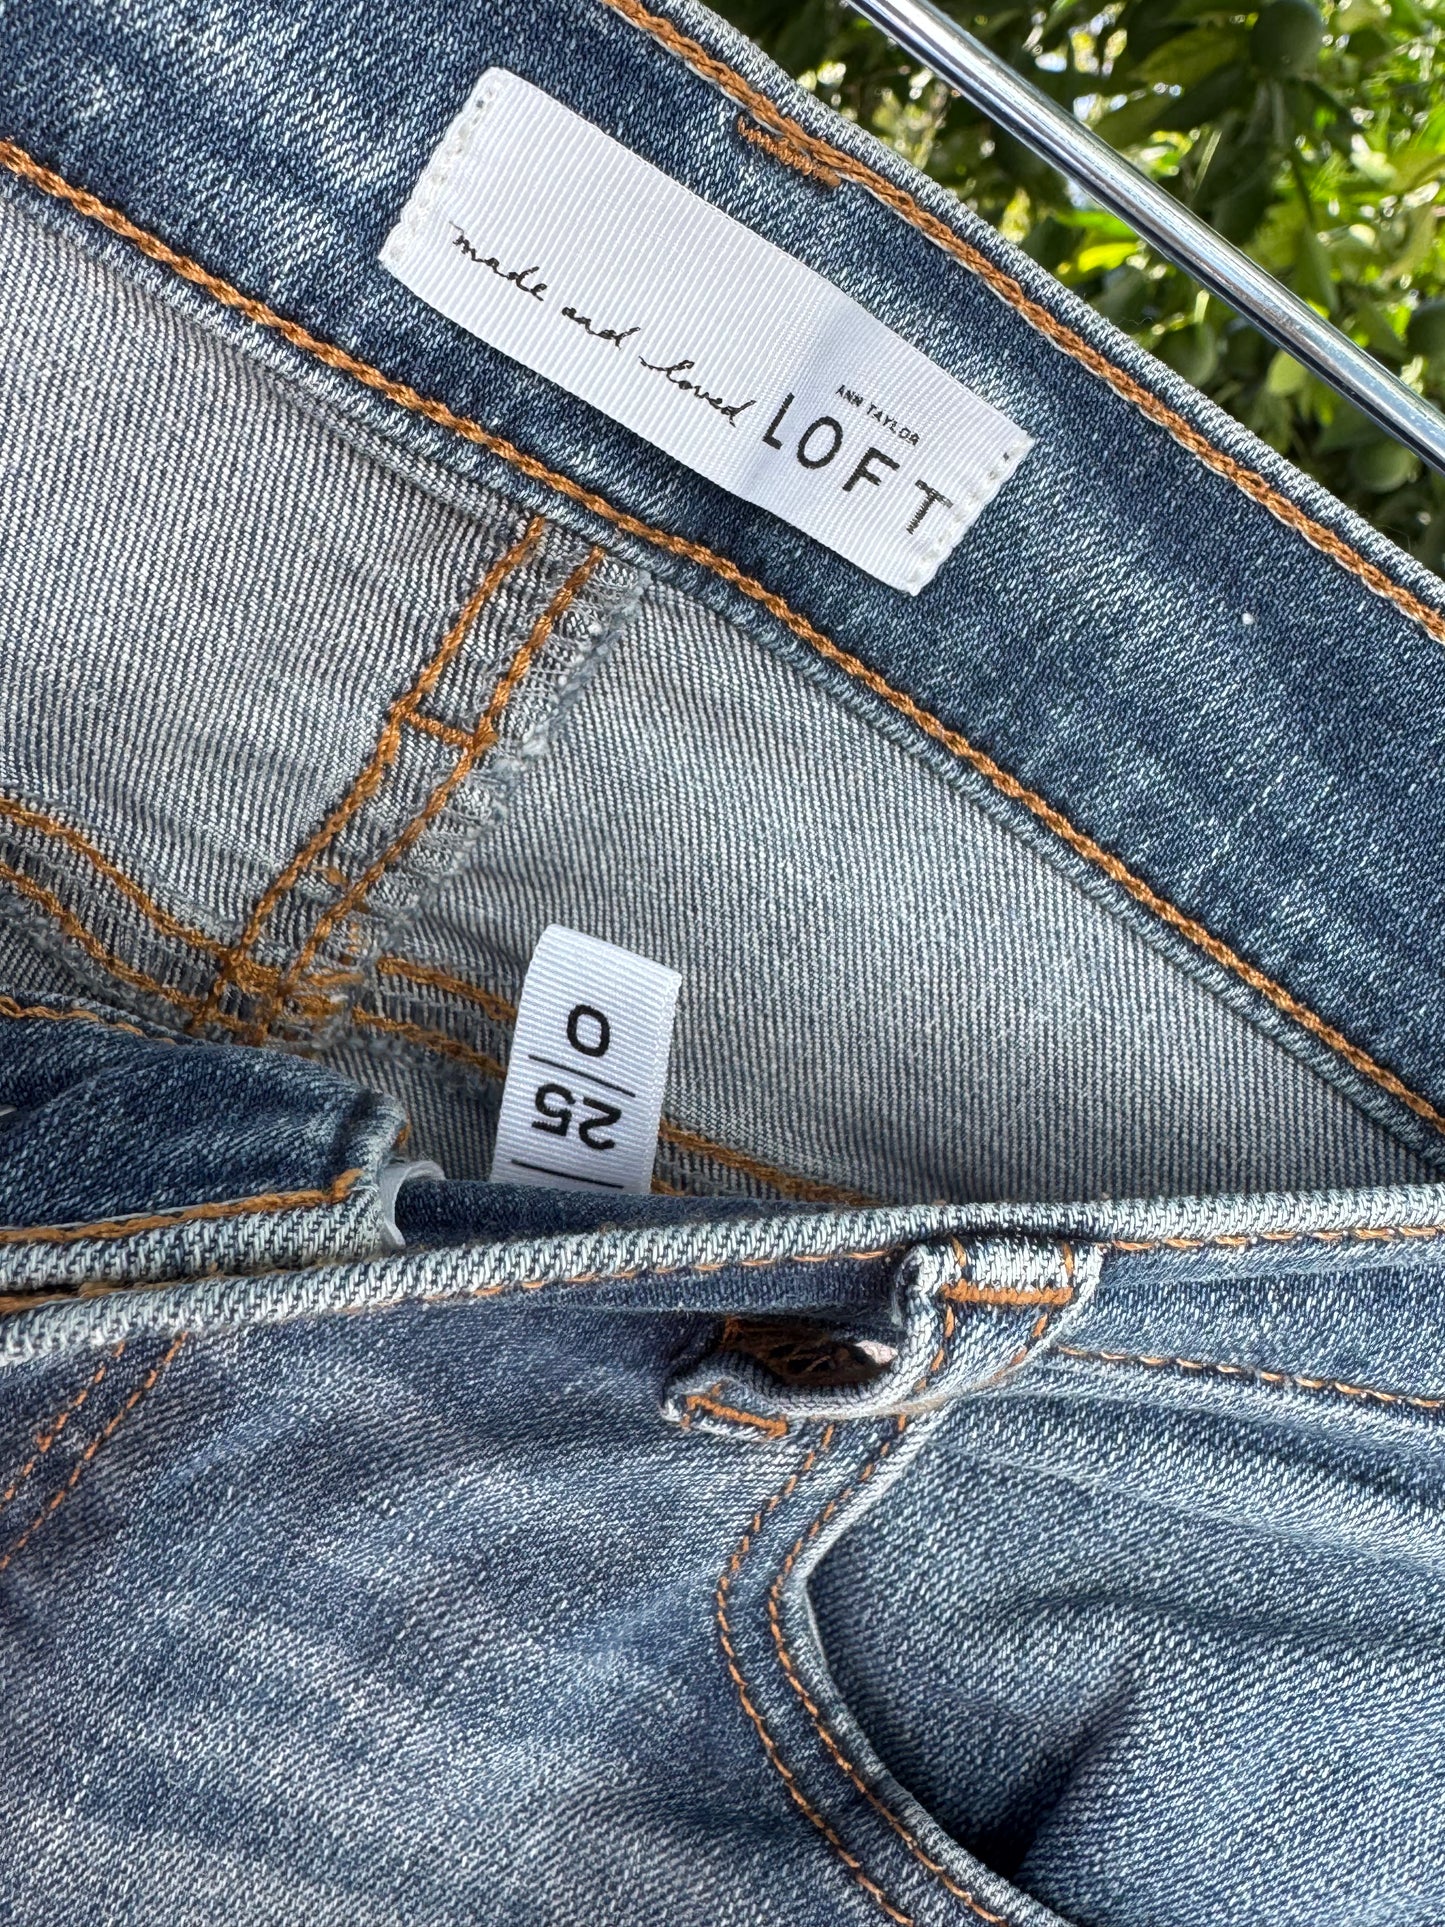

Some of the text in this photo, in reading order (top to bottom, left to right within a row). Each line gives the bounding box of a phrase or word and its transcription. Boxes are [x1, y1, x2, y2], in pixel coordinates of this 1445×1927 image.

[448, 220, 757, 427] made and loved
[835, 384, 920, 446] ANN TAYLOR
[762, 392, 954, 535] LOFT
[566, 1004, 611, 1058] 0
[532, 1082, 623, 1151] 25
